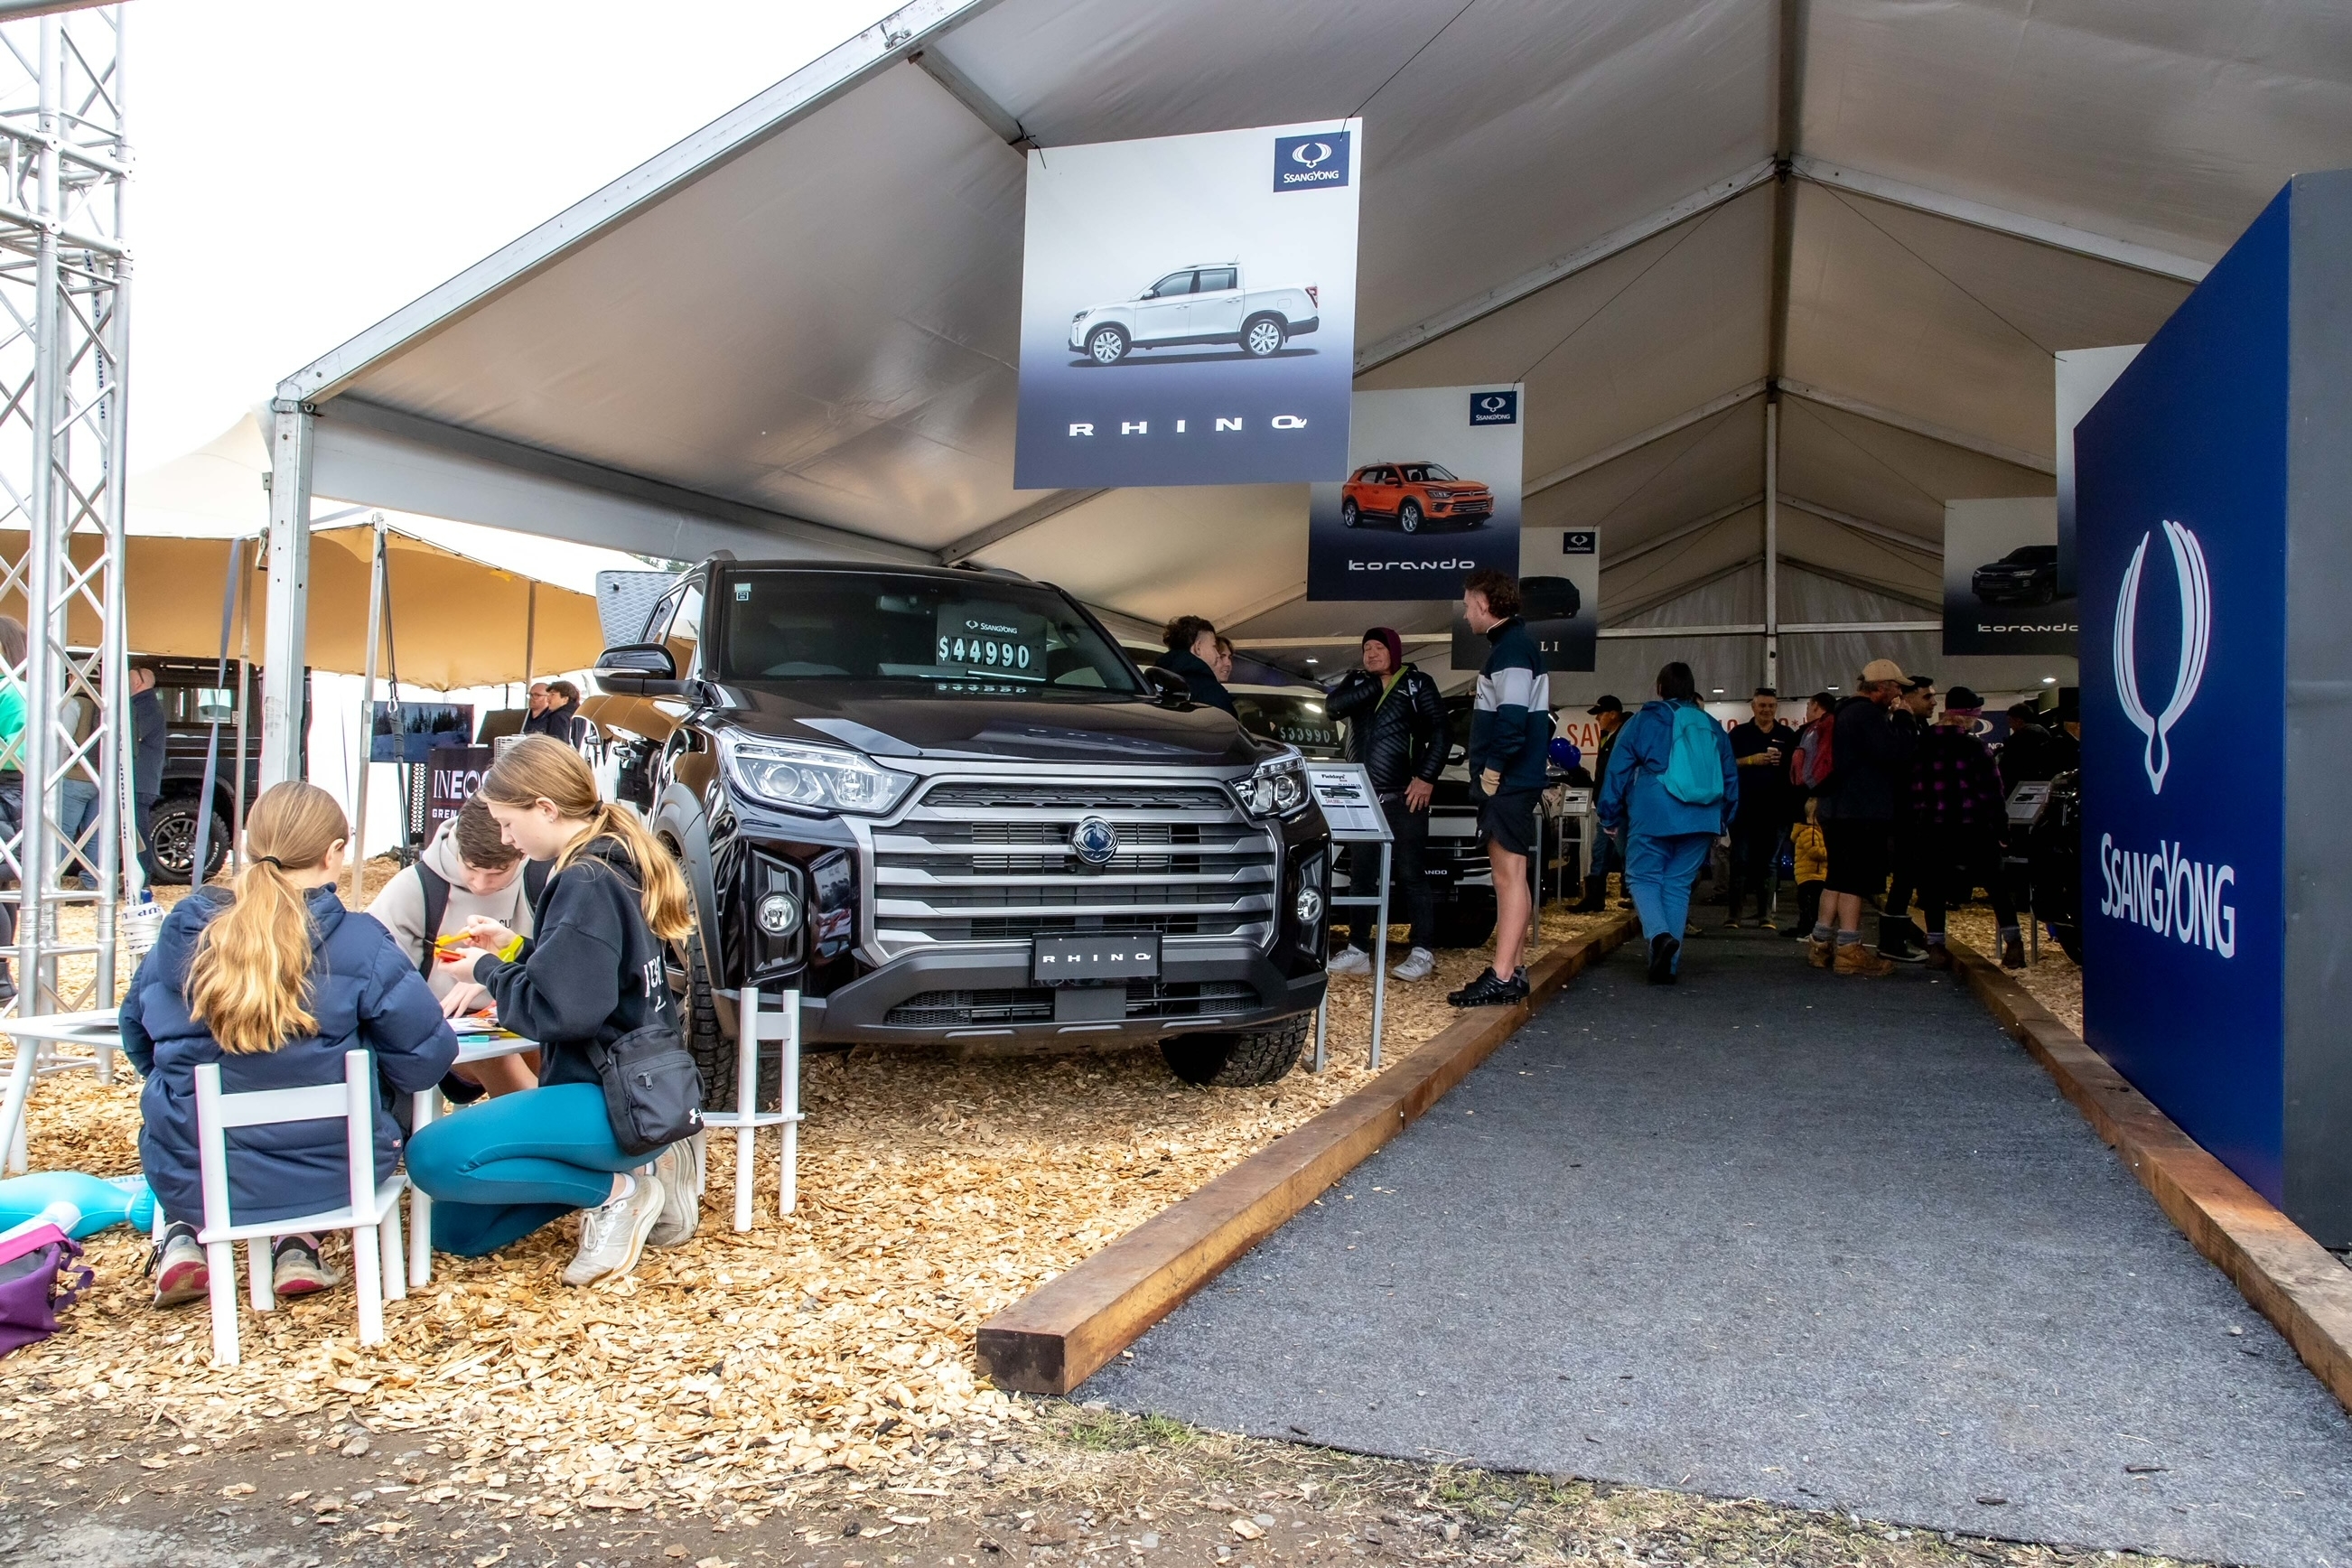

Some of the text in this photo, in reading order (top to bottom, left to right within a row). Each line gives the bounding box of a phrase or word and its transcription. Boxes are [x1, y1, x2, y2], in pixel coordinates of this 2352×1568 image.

[1069, 415, 1308, 436] RHINO
[1348, 558, 1476, 571] korando
[938, 635, 1030, 668] $44990
[1280, 726, 1330, 742] $33990
[1042, 953, 1152, 963] RHINO
